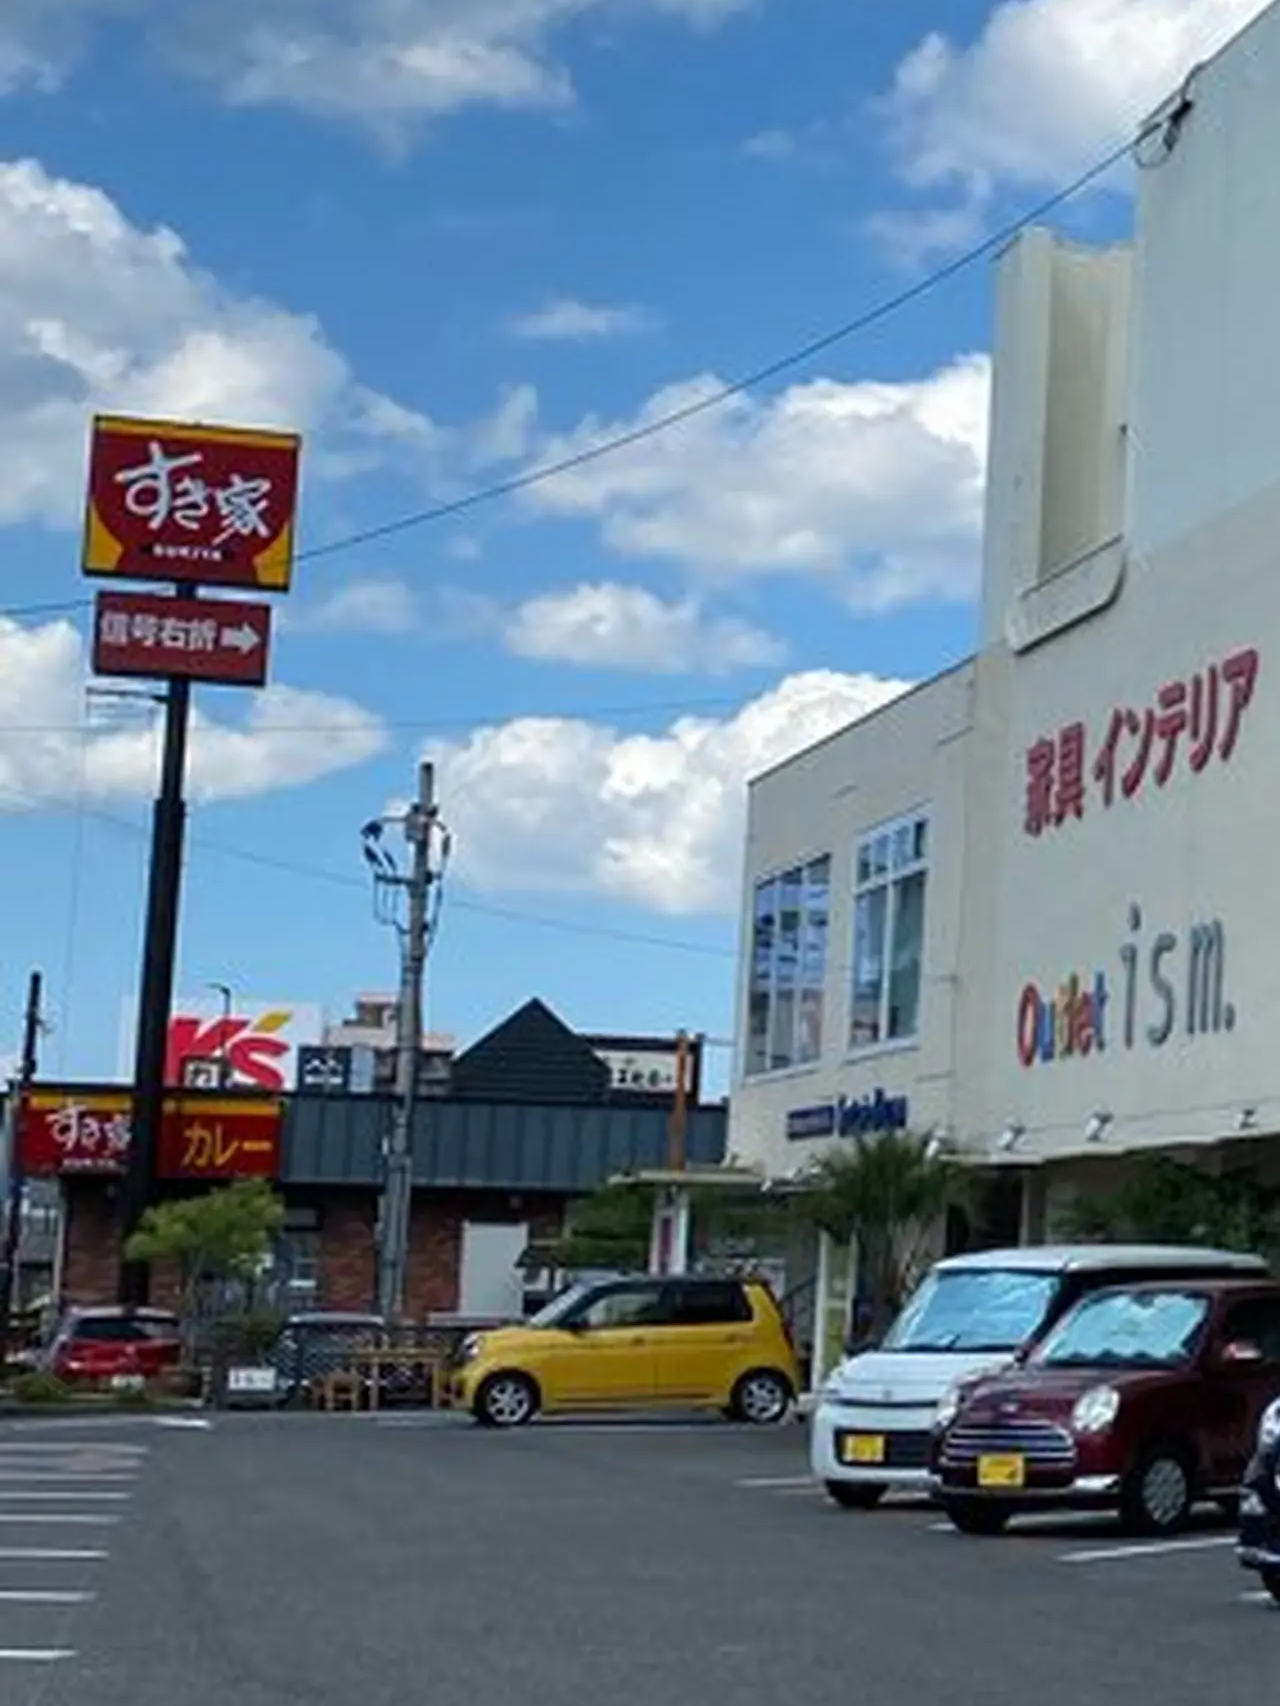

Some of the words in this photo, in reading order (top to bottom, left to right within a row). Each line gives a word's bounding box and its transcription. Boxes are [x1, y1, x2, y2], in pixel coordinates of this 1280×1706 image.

[114, 439, 273, 546] すき家
[100, 611, 217, 651] 信号右折
[1023, 721, 1086, 837] 家具
[1094, 647, 1260, 811] インテリア
[1017, 970, 1109, 1069] Outlet
[1119, 901, 1237, 1050] ism.
[180, 1120, 273, 1169] カレー
